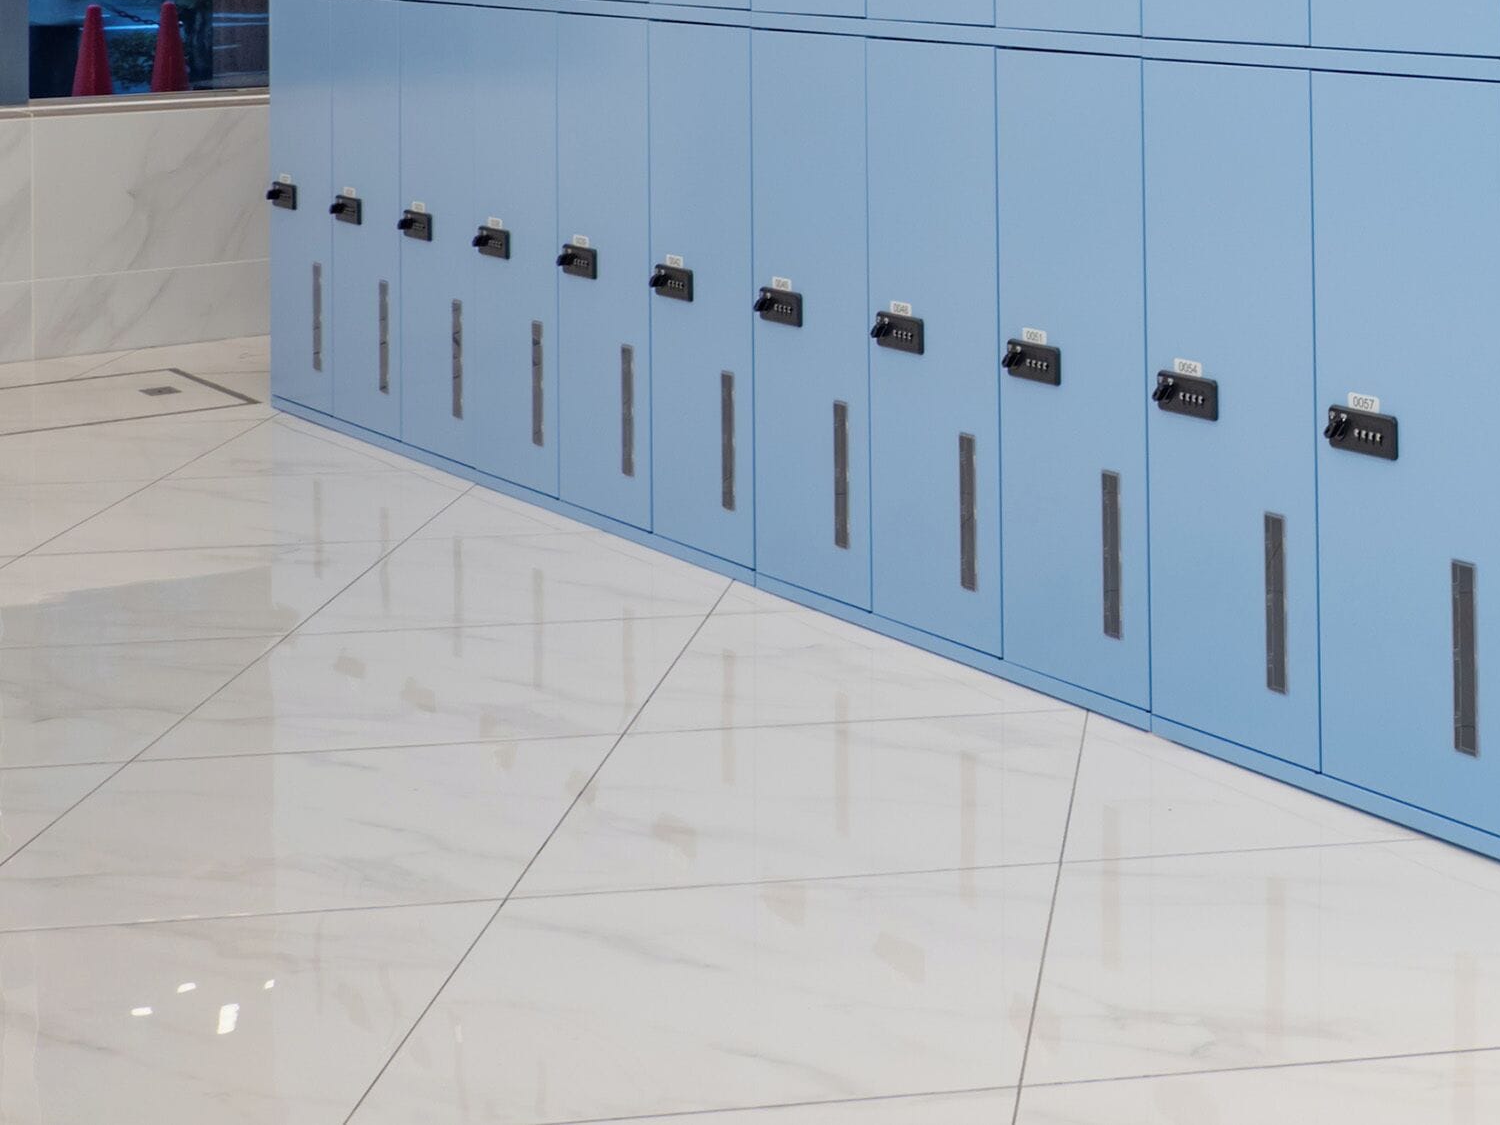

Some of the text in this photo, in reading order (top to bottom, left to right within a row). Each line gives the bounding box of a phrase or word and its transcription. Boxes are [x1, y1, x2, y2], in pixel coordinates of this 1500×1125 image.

[1025, 330, 1044, 343] 0051
[1178, 361, 1197, 374] 0054
[1352, 396, 1374, 410] 0057
